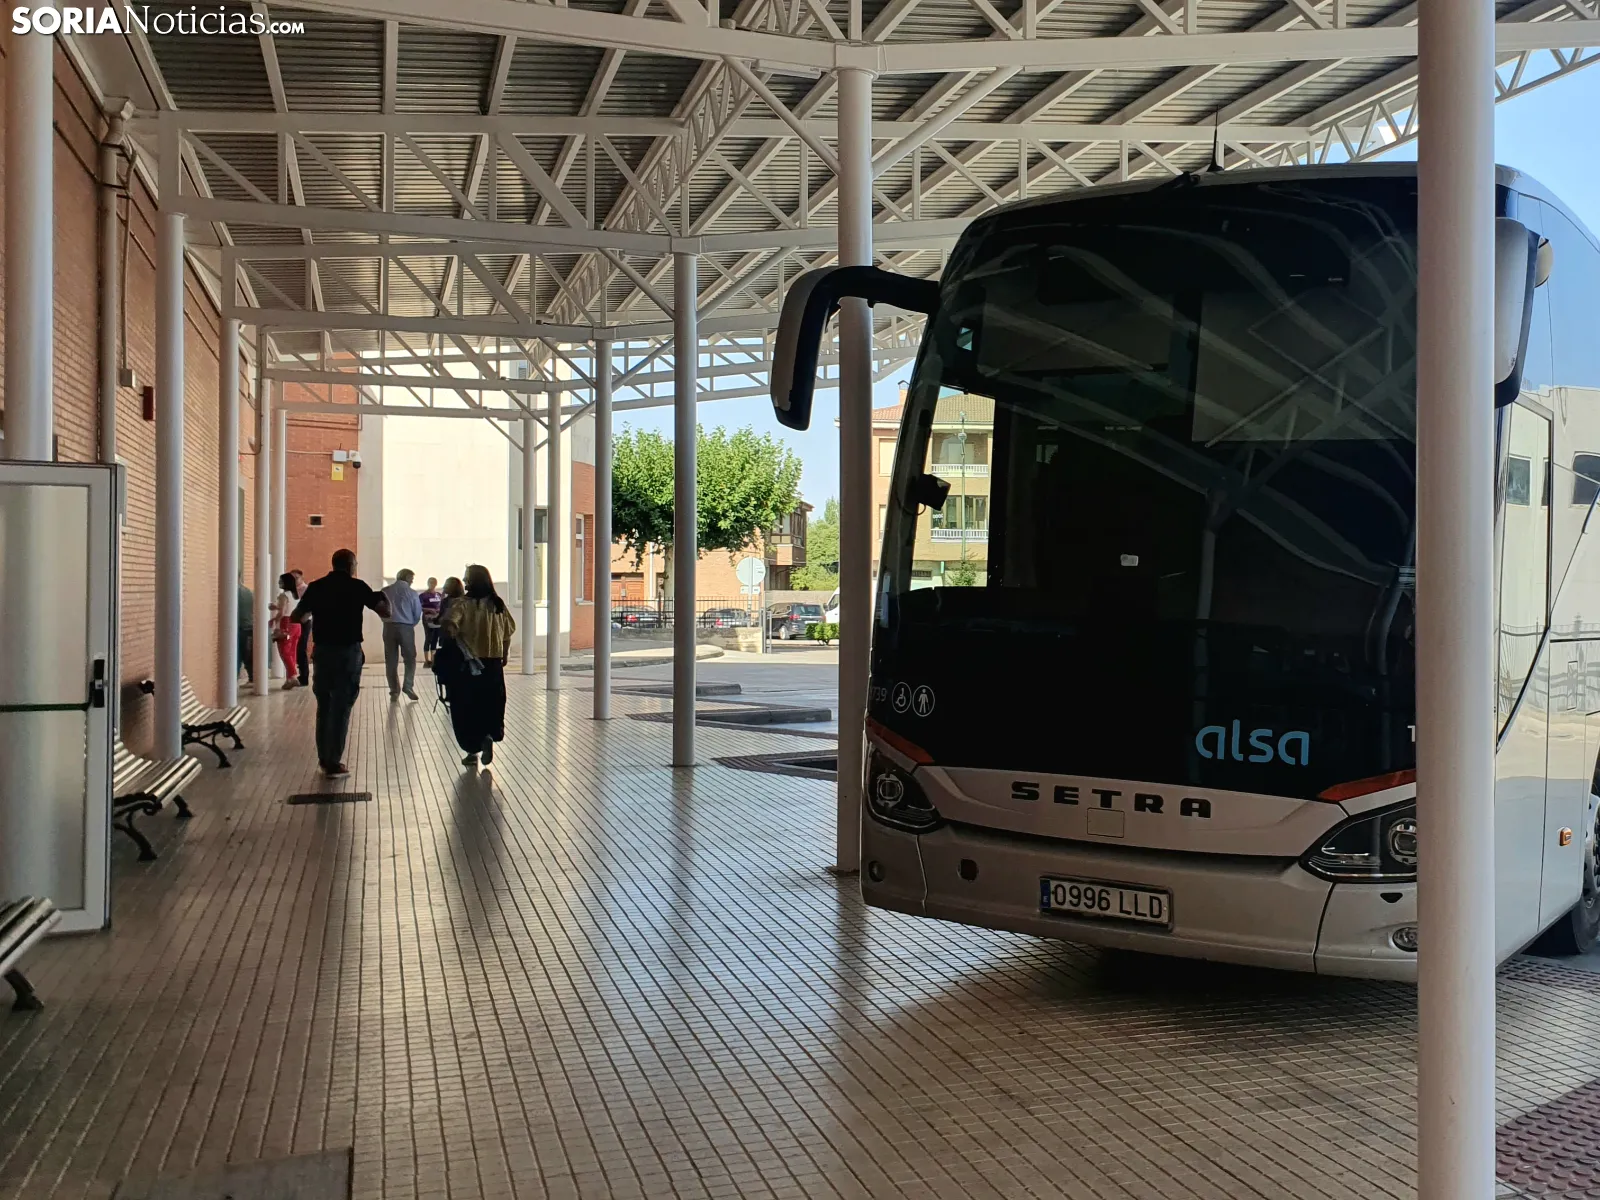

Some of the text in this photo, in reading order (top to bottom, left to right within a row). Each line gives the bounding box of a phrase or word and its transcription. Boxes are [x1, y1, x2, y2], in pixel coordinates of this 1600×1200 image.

[1195, 719, 1310, 766] alsa
[1011, 781, 1211, 819] SETRA
[1054, 884, 1111, 911] 0996
[1119, 891, 1162, 918] LLD
